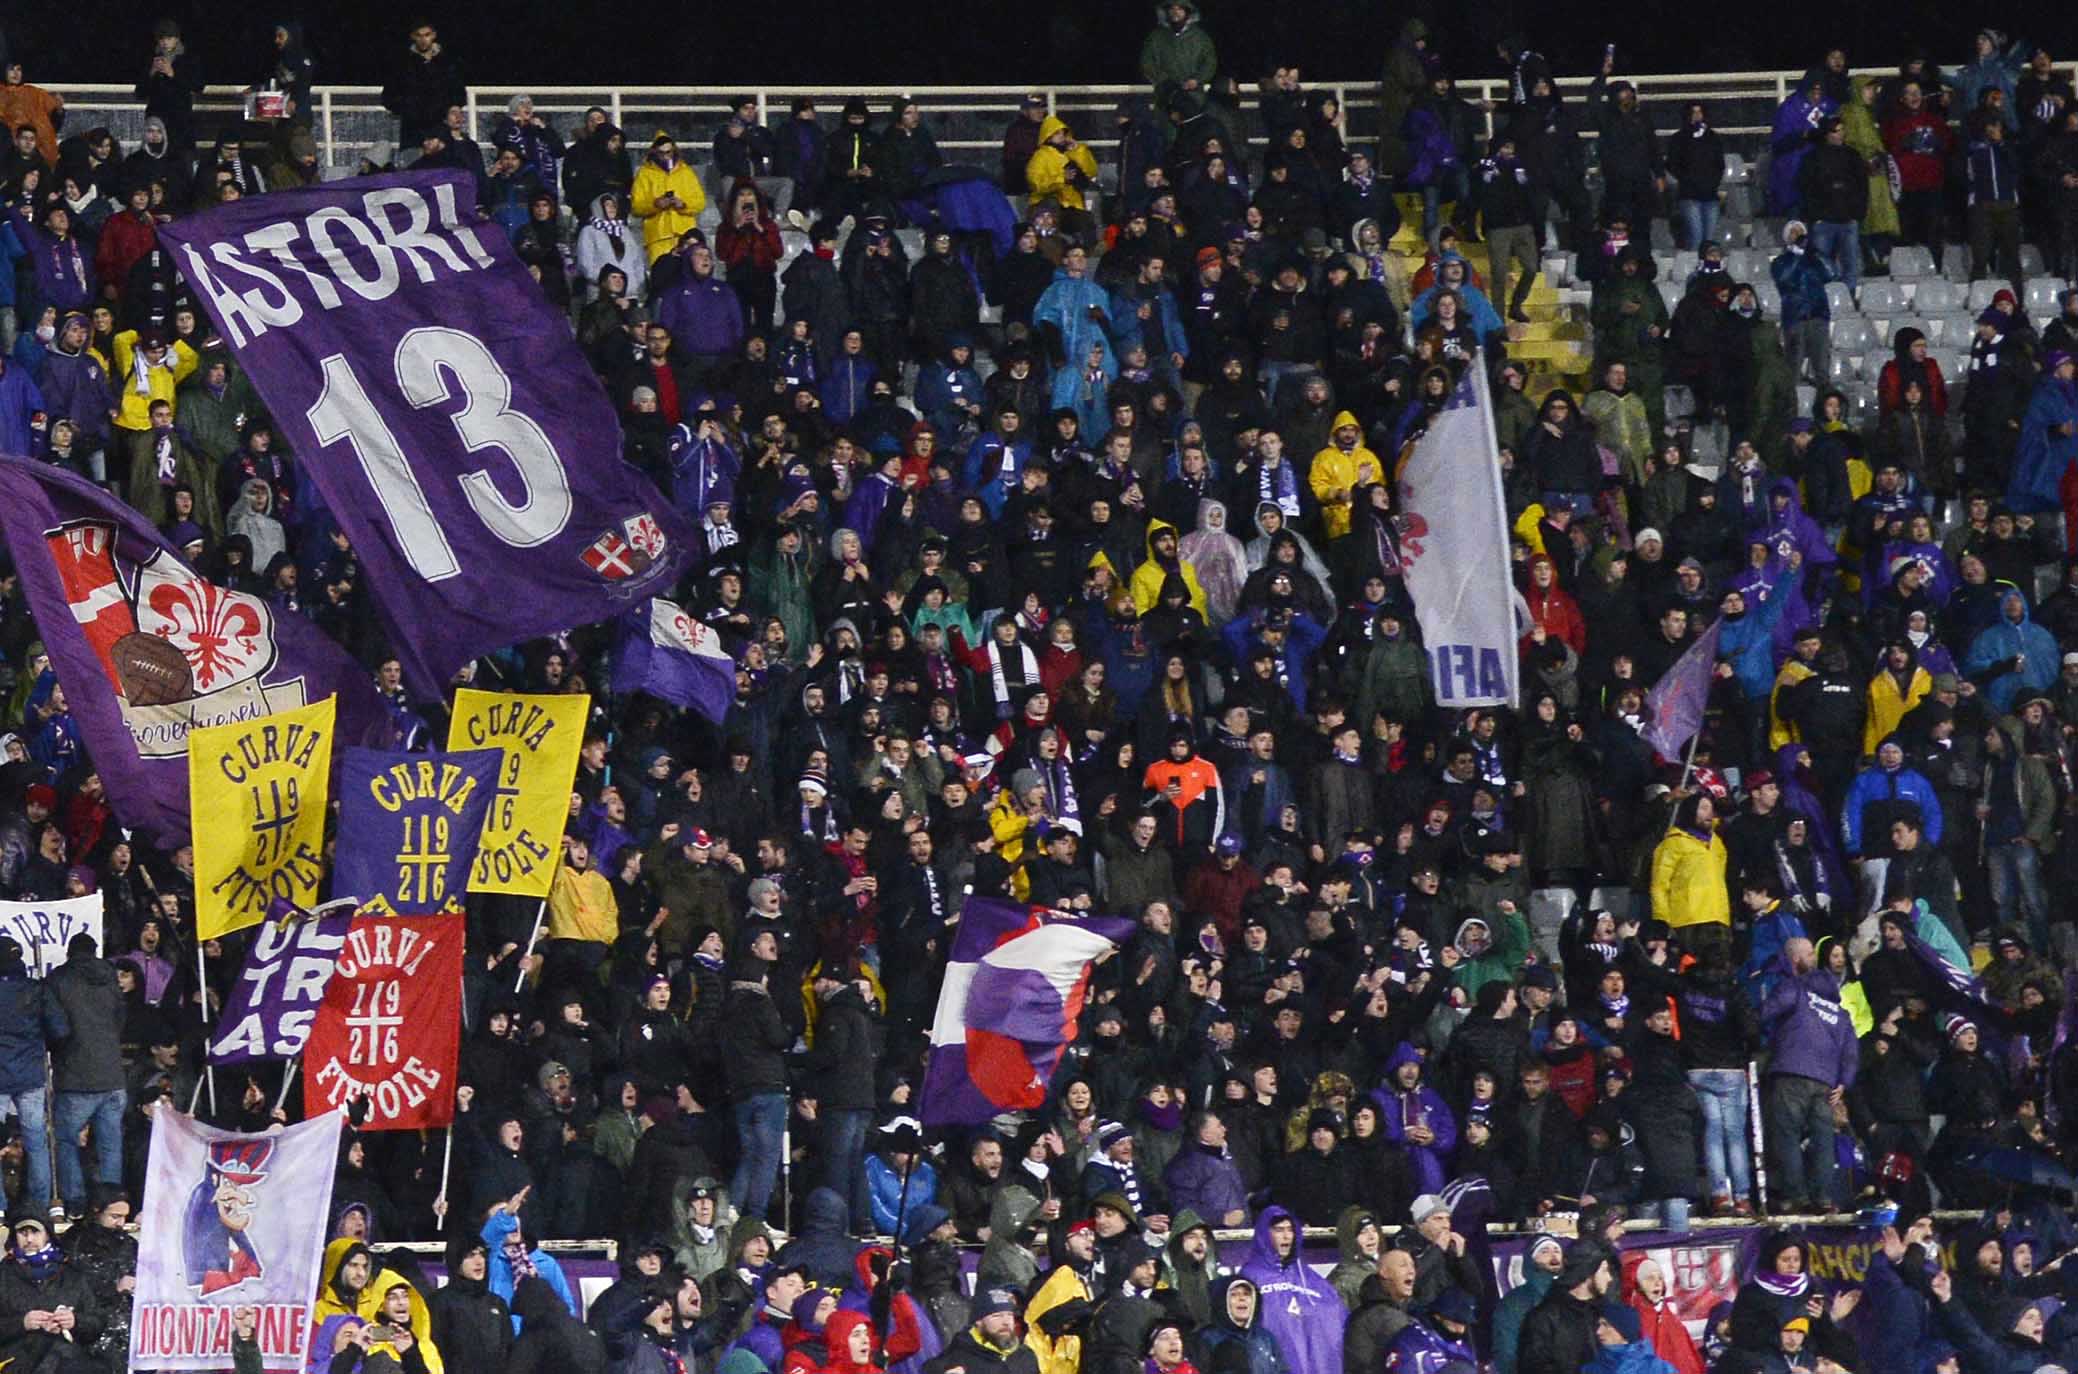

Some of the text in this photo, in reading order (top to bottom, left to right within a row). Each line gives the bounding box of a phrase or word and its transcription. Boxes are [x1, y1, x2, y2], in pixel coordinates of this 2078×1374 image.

[181, 184, 495, 350] ASTORI
[306, 326, 573, 583] 13
[468, 701, 555, 753] CURVA
[220, 724, 321, 784] CURVA
[507, 752, 521, 785] 9
[369, 761, 478, 815] CURVA
[477, 829, 551, 884] SOLE
[0, 911, 90, 949] URV
[244, 956, 335, 1007] TR
[211, 1009, 316, 1056] AS
